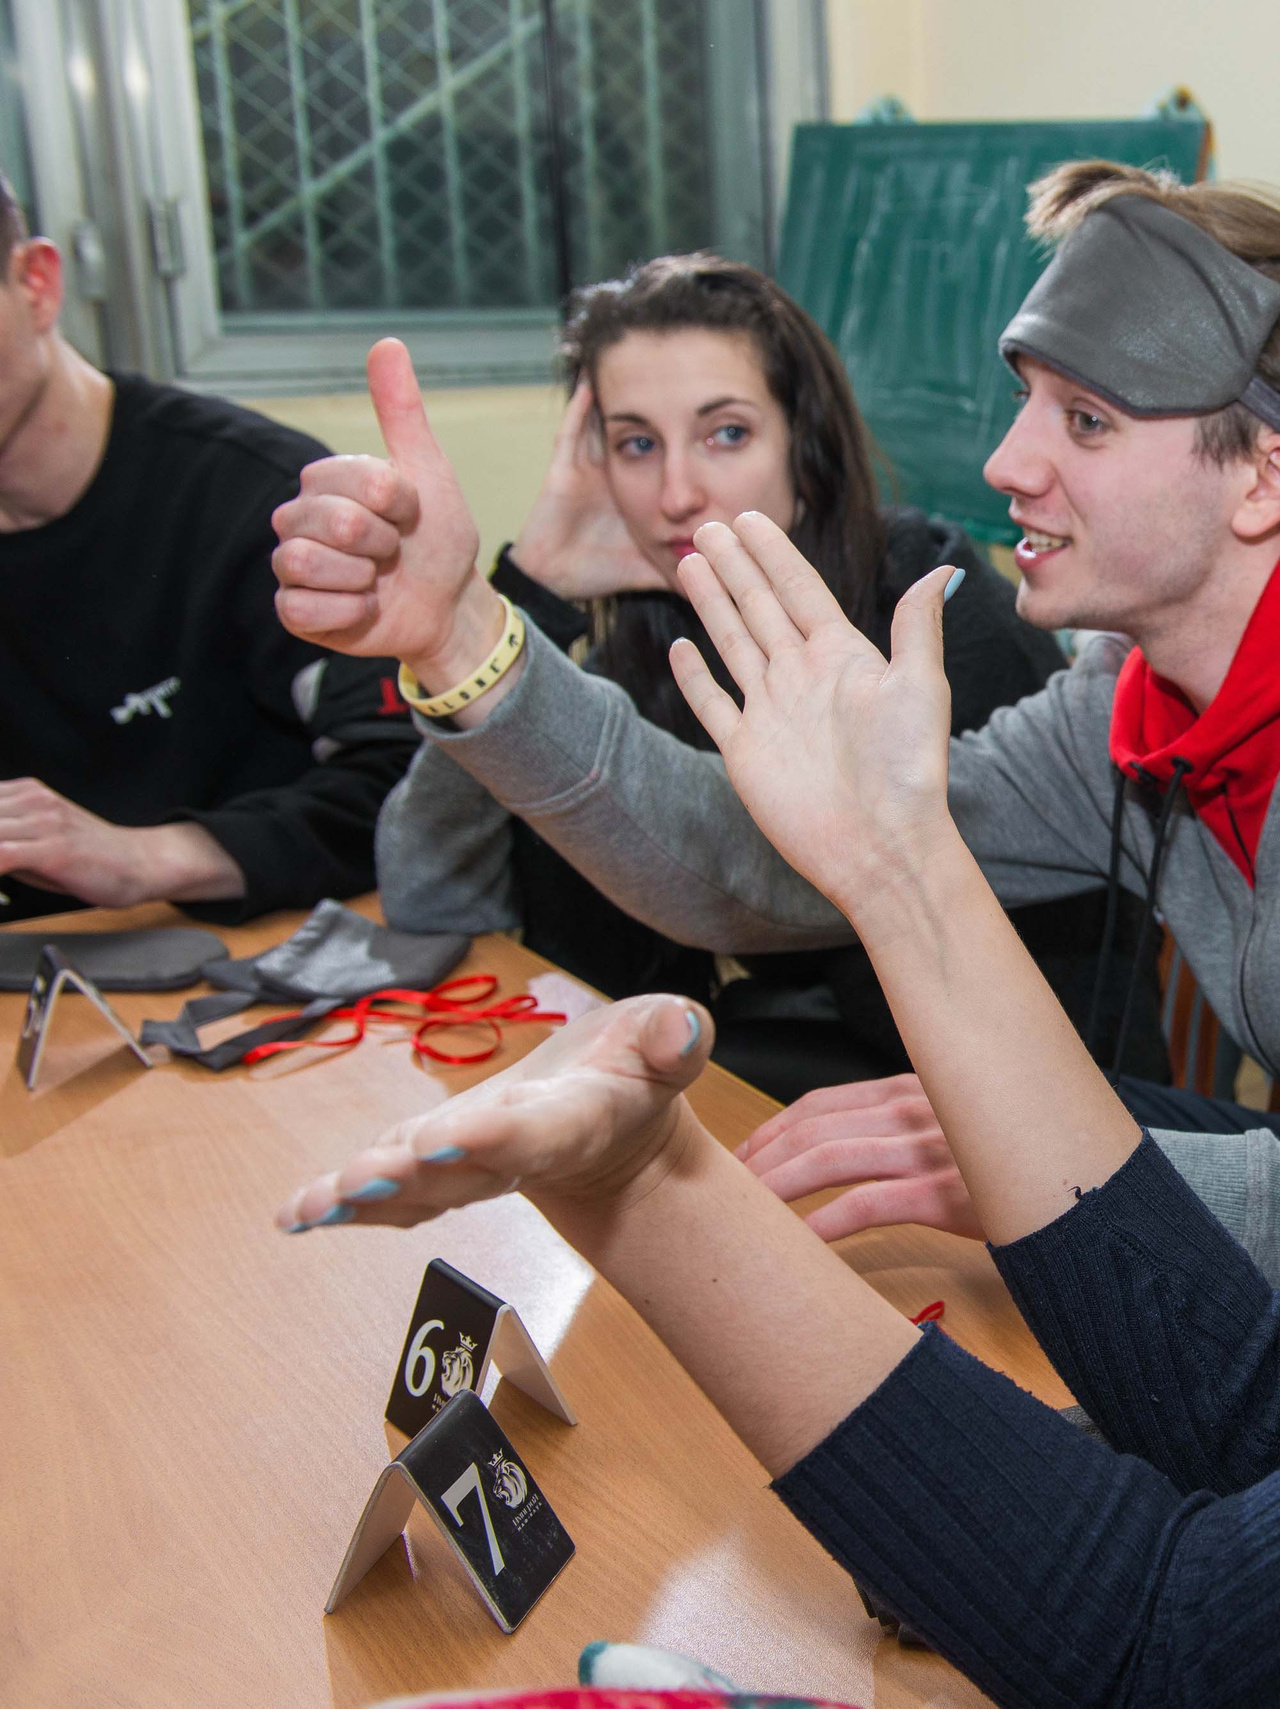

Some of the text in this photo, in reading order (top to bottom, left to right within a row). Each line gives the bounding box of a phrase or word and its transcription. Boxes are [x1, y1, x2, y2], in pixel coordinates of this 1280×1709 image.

[428, 657, 501, 714] ALONE
[404, 1319, 445, 1398] 6
[441, 1462, 506, 1576] 7
